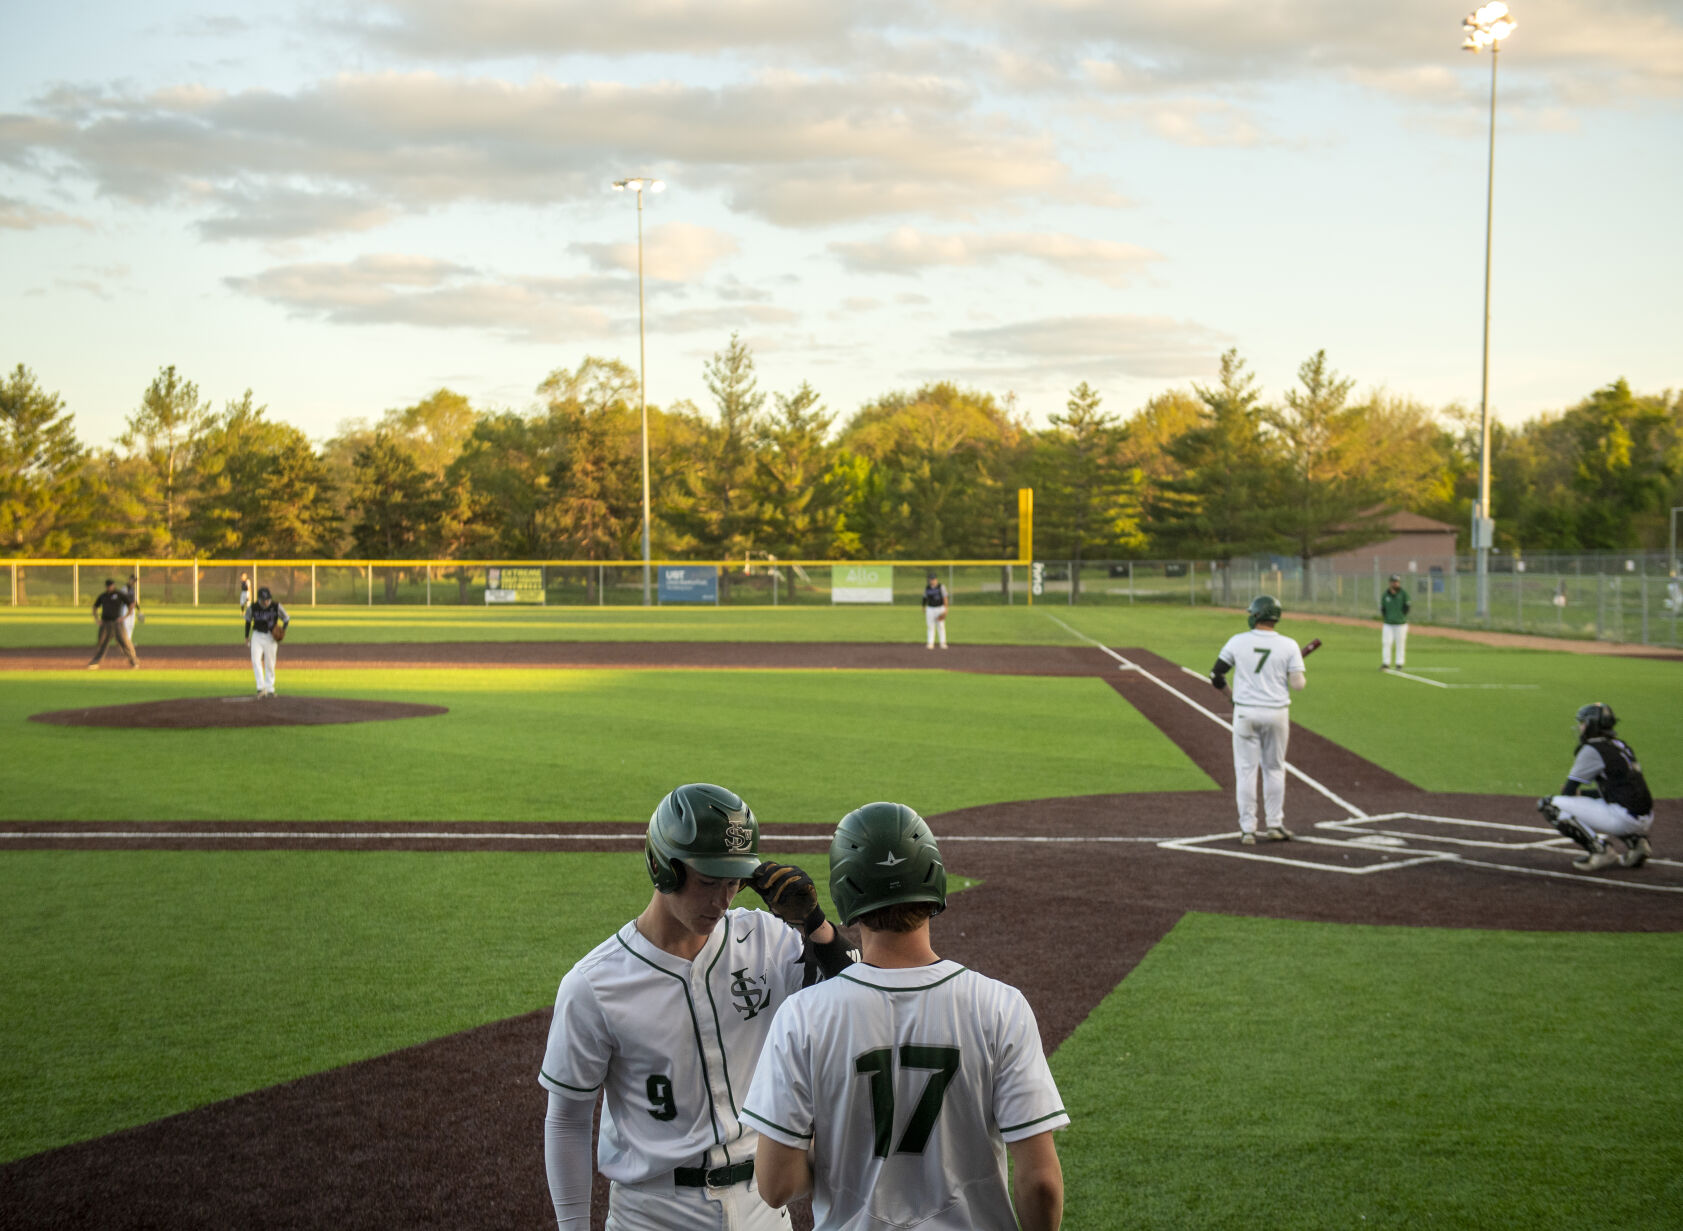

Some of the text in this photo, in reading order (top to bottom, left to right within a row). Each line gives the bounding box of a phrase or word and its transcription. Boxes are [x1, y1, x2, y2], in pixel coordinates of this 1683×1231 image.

[1253, 647, 1271, 674] 7
[646, 1074, 678, 1122] 9
[854, 1043, 961, 1160] 17
